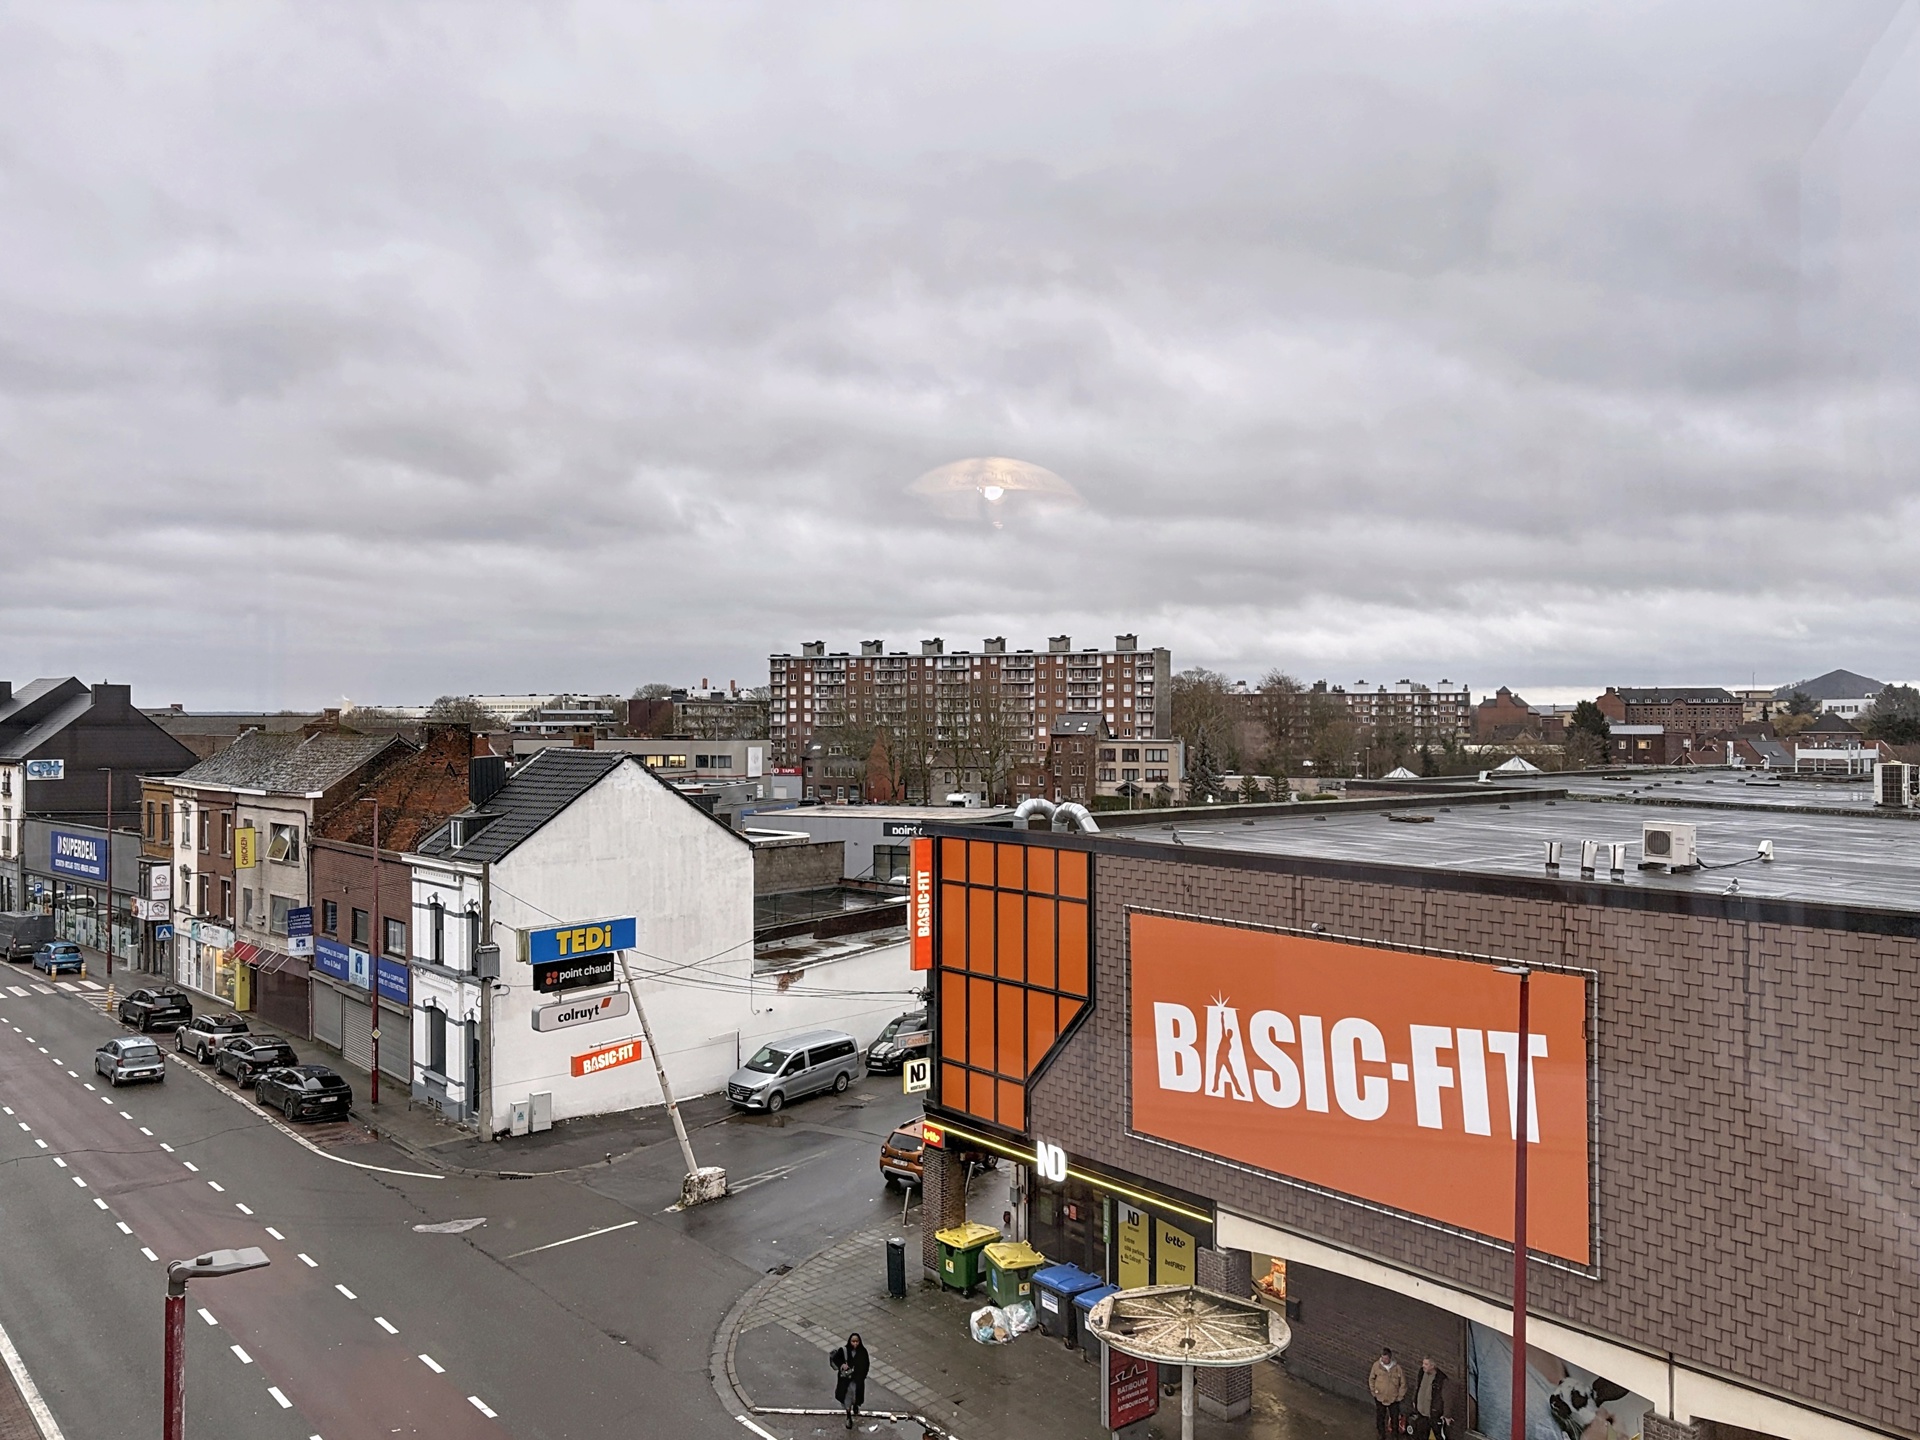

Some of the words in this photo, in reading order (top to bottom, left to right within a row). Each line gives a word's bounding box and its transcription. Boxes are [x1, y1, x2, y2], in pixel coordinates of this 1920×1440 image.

[62, 836, 98, 861] SUPERDEAL
[240, 836, 249, 866] CHICKEN
[917, 870, 930, 937] BASIC-FIT
[556, 925, 612, 956] TEDi
[559, 968, 582, 983] point
[584, 962, 612, 976] chaud
[558, 1004, 600, 1023] colruyt
[907, 1035, 929, 1046] Gazette
[583, 1044, 634, 1075] BASIC-FIT
[1153, 1000, 1549, 1144] BASIC-FIT
[910, 1063, 926, 1084] ND
[1037, 1140, 1066, 1182] ND
[1127, 1209, 1139, 1227] ND
[1117, 1377, 1148, 1395] BATIBOUW
